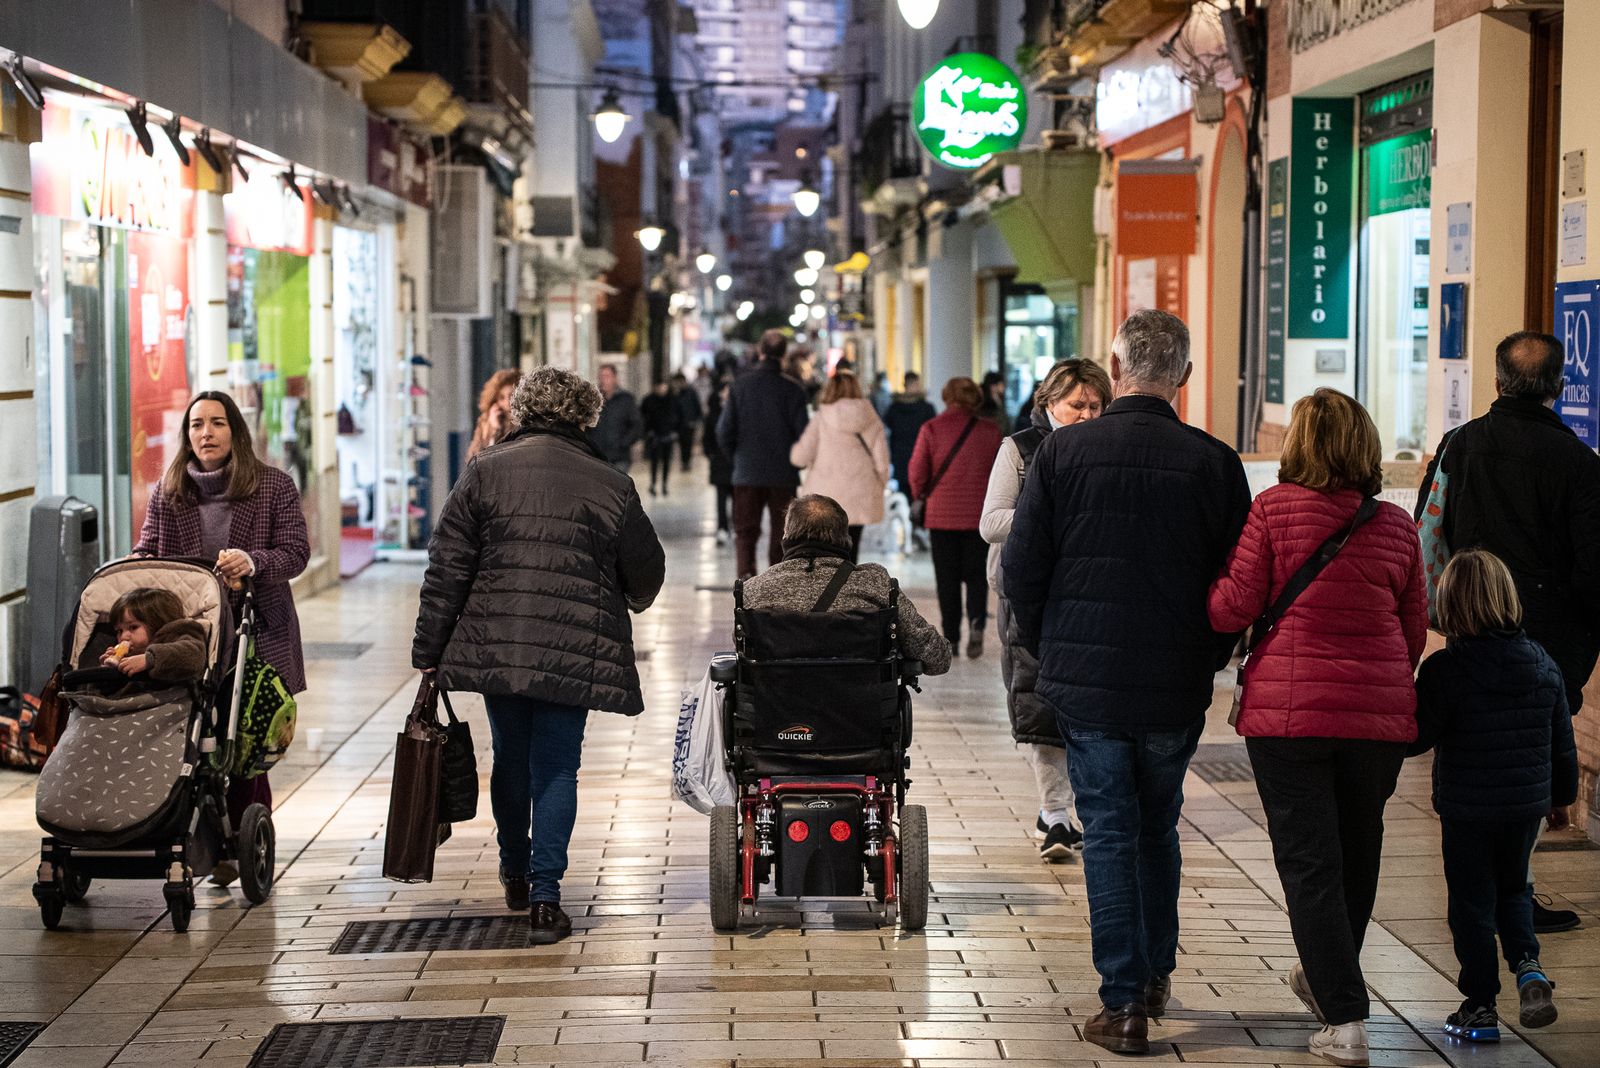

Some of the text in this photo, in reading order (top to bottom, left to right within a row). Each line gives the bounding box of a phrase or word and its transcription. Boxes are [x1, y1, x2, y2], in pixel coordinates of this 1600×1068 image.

[1311, 112, 1332, 324] Herbolario
[1563, 309, 1590, 377] EQ
[1561, 375, 1590, 403] Fincas
[777, 732, 812, 740] QUICKIE
